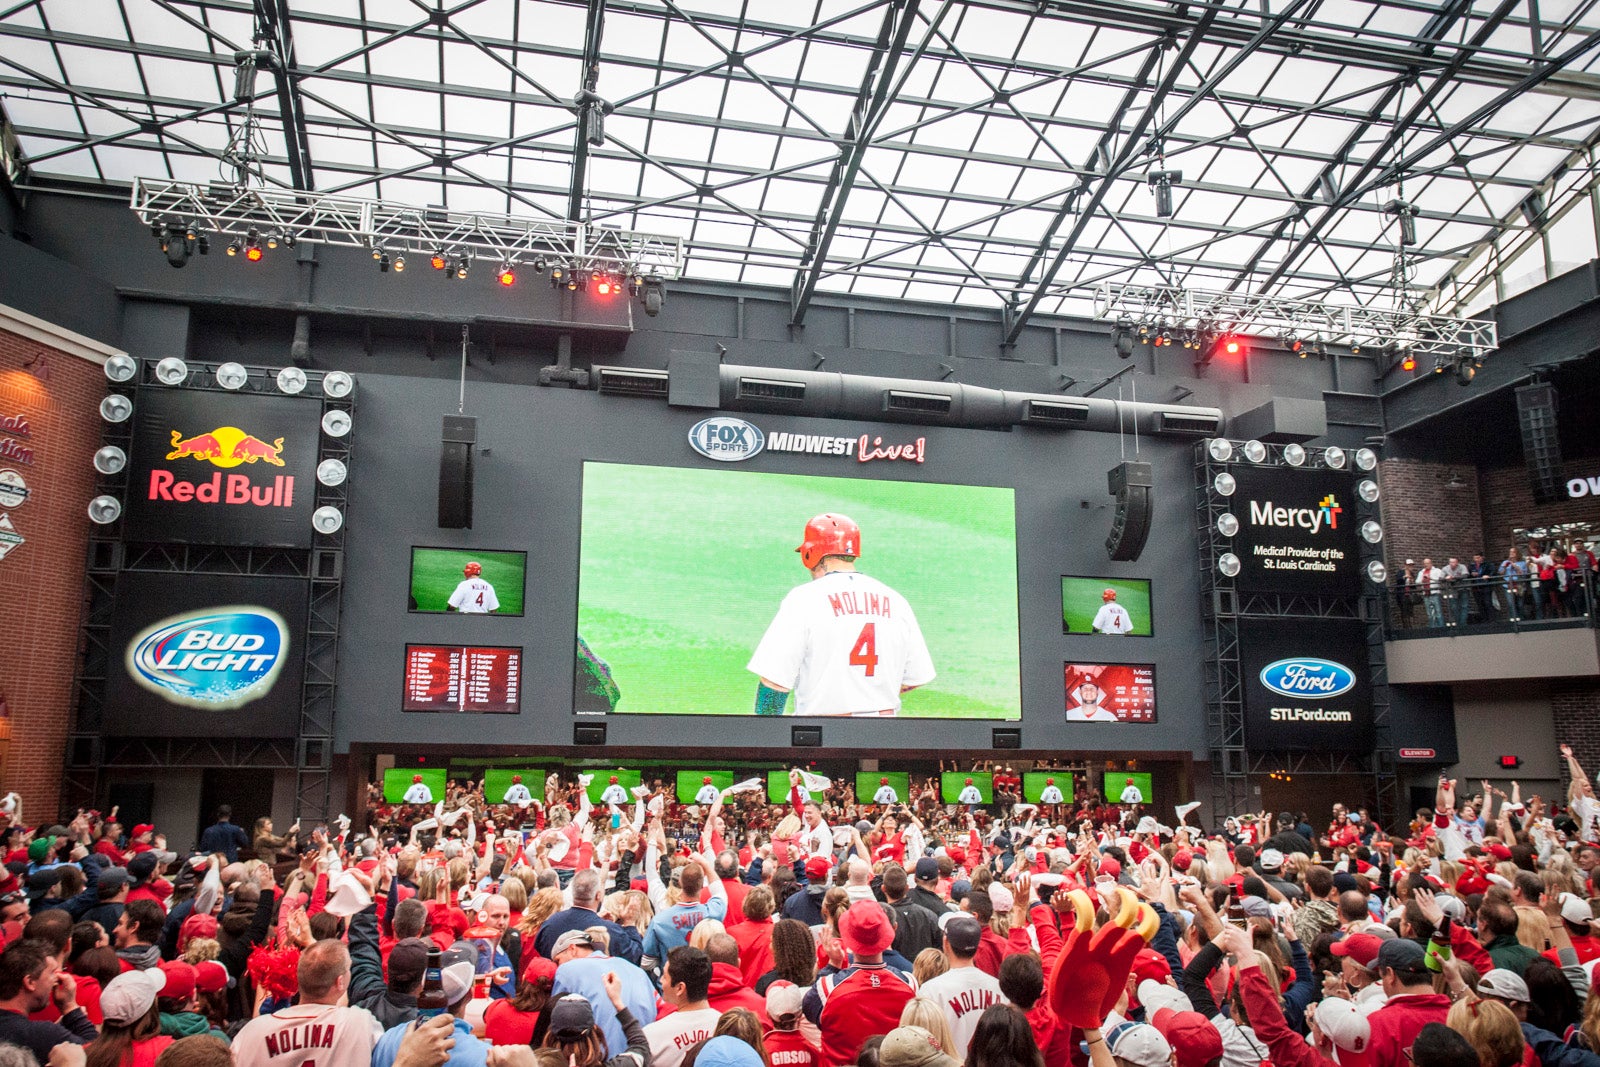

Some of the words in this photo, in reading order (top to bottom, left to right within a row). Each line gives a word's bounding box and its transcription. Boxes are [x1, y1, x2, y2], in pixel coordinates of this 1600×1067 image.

[706, 425, 748, 444] FOX
[706, 443, 748, 452] SPORTS
[767, 431, 857, 456] MIDWEST
[858, 434, 925, 463] Live!
[148, 469, 222, 503] Red
[225, 474, 295, 507] Bull
[1250, 500, 1323, 534] Mercy
[1254, 545, 1287, 556] Medical
[1287, 546, 1321, 558] Provider
[1320, 548, 1331, 560] of
[1330, 548, 1344, 559] the
[1264, 559, 1276, 569] St.
[1276, 560, 1298, 570] Louis
[1298, 560, 1336, 571] Cardinals
[475, 592, 484, 607] 4
[828, 592, 891, 619] MOLINA
[178, 630, 265, 652] BUD
[849, 622, 879, 677] 4
[156, 650, 275, 672] LIGHT
[1280, 664, 1336, 691] Ford
[1270, 708, 1352, 721] STLFord.com
[265, 1023, 335, 1058] MOLINA
[771, 1050, 812, 1066] GIBSON
